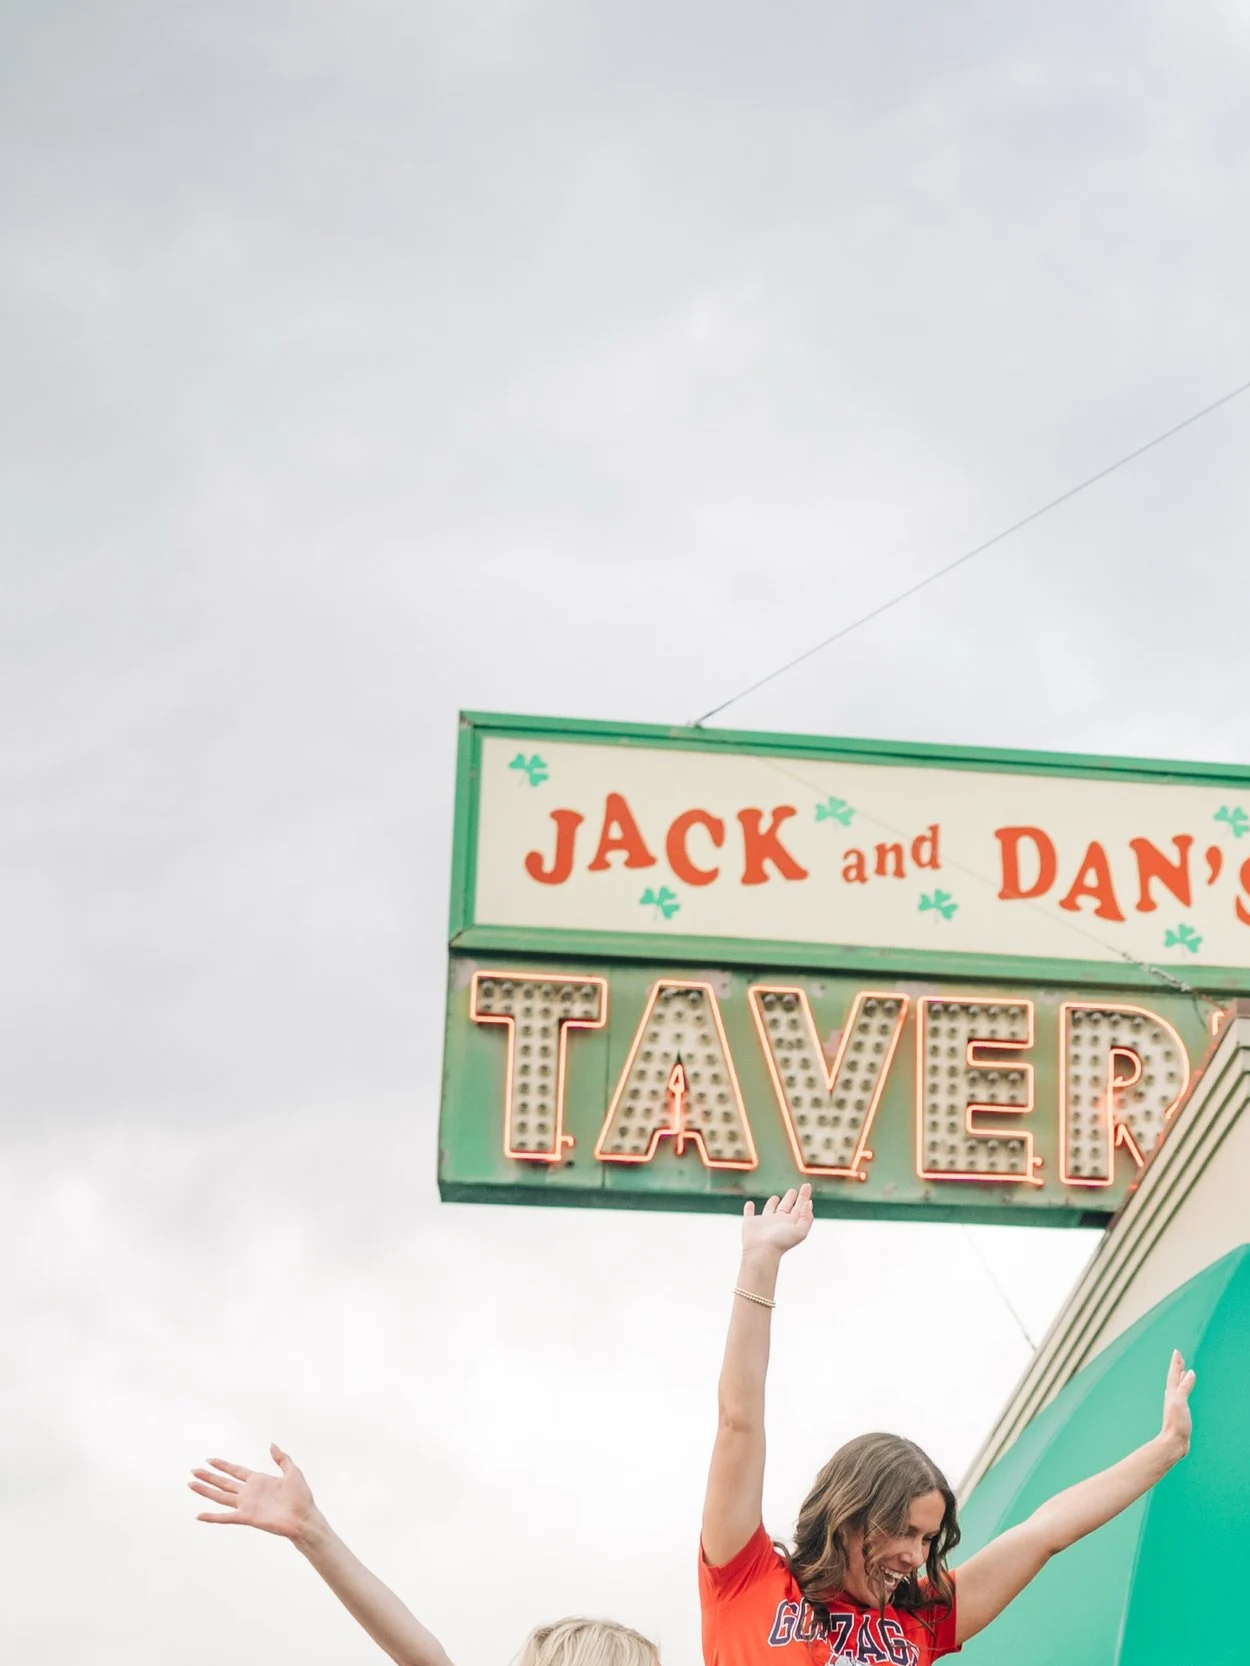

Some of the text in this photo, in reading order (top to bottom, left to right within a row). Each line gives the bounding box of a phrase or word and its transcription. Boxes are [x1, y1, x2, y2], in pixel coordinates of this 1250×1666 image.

[525, 792, 808, 887] JACK
[842, 824, 942, 884] and
[470, 970, 1225, 1187] TAVER
